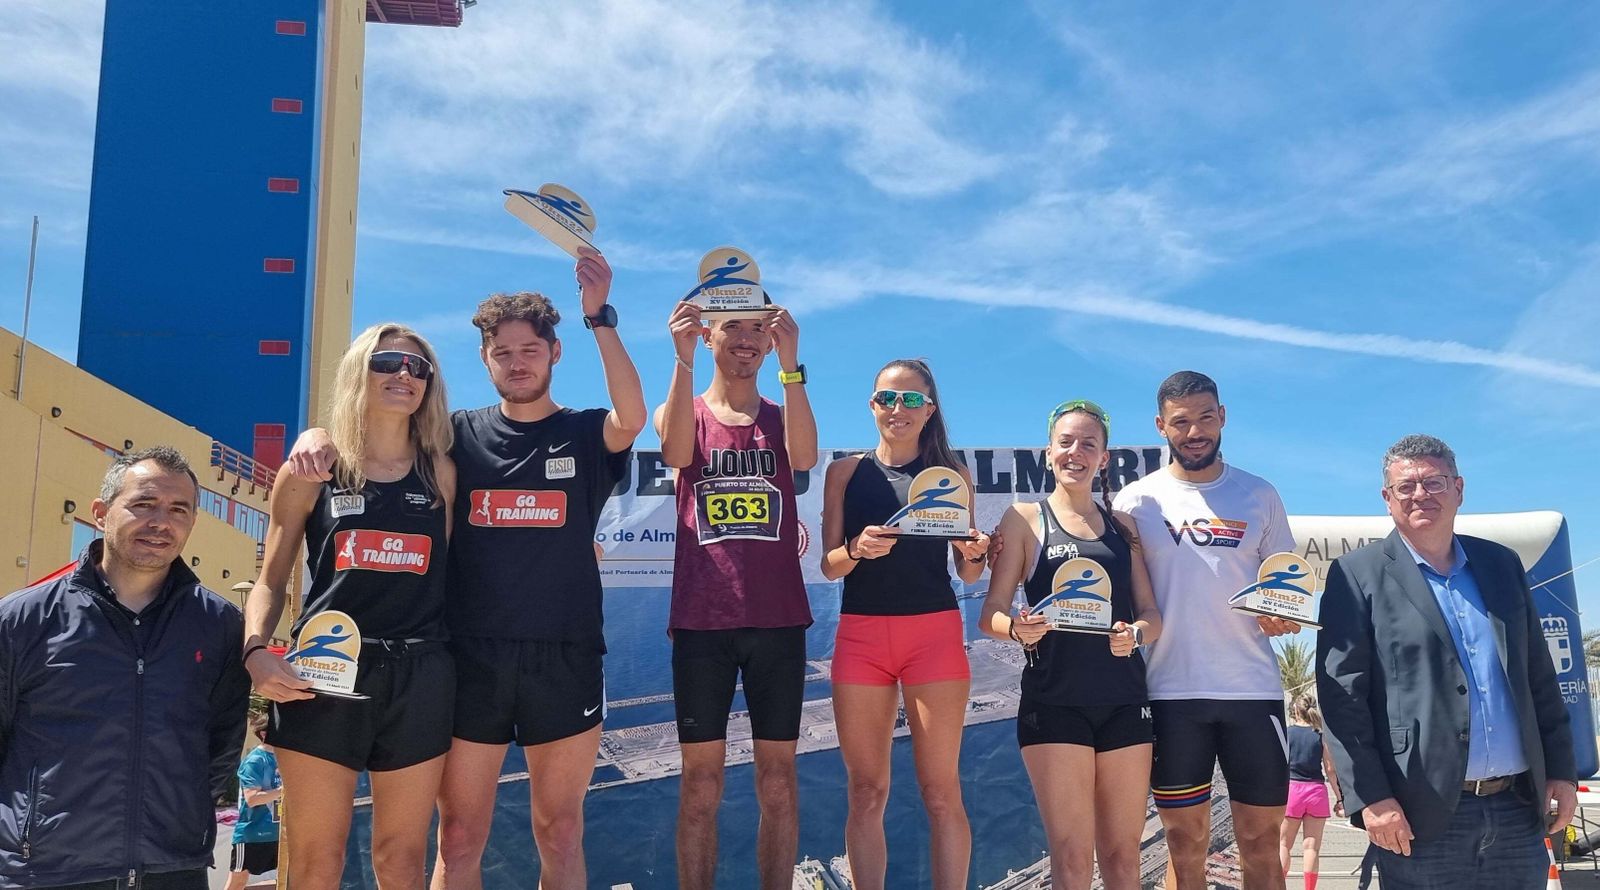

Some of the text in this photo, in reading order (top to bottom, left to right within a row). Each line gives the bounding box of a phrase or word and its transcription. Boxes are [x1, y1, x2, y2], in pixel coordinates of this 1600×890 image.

[700, 287, 752, 296] 10km22
[702, 449, 777, 478] JOUD
[515, 495, 536, 507] GQ
[711, 497, 767, 520] 363
[496, 508, 559, 520] TRAINING
[908, 509, 959, 520] 10km22
[613, 529, 635, 542] de
[382, 537, 404, 552] GQ
[1048, 543, 1079, 558] NEXA
[1303, 537, 1384, 562] ALM
[362, 548, 425, 567] TRAINING
[1255, 587, 1305, 604] 10km22
[1052, 599, 1101, 611] 10km22
[1273, 602, 1299, 612] Edición
[294, 656, 347, 673] 10km22
[311, 673, 339, 682] Edición
[1559, 678, 1588, 695] ERÍA
